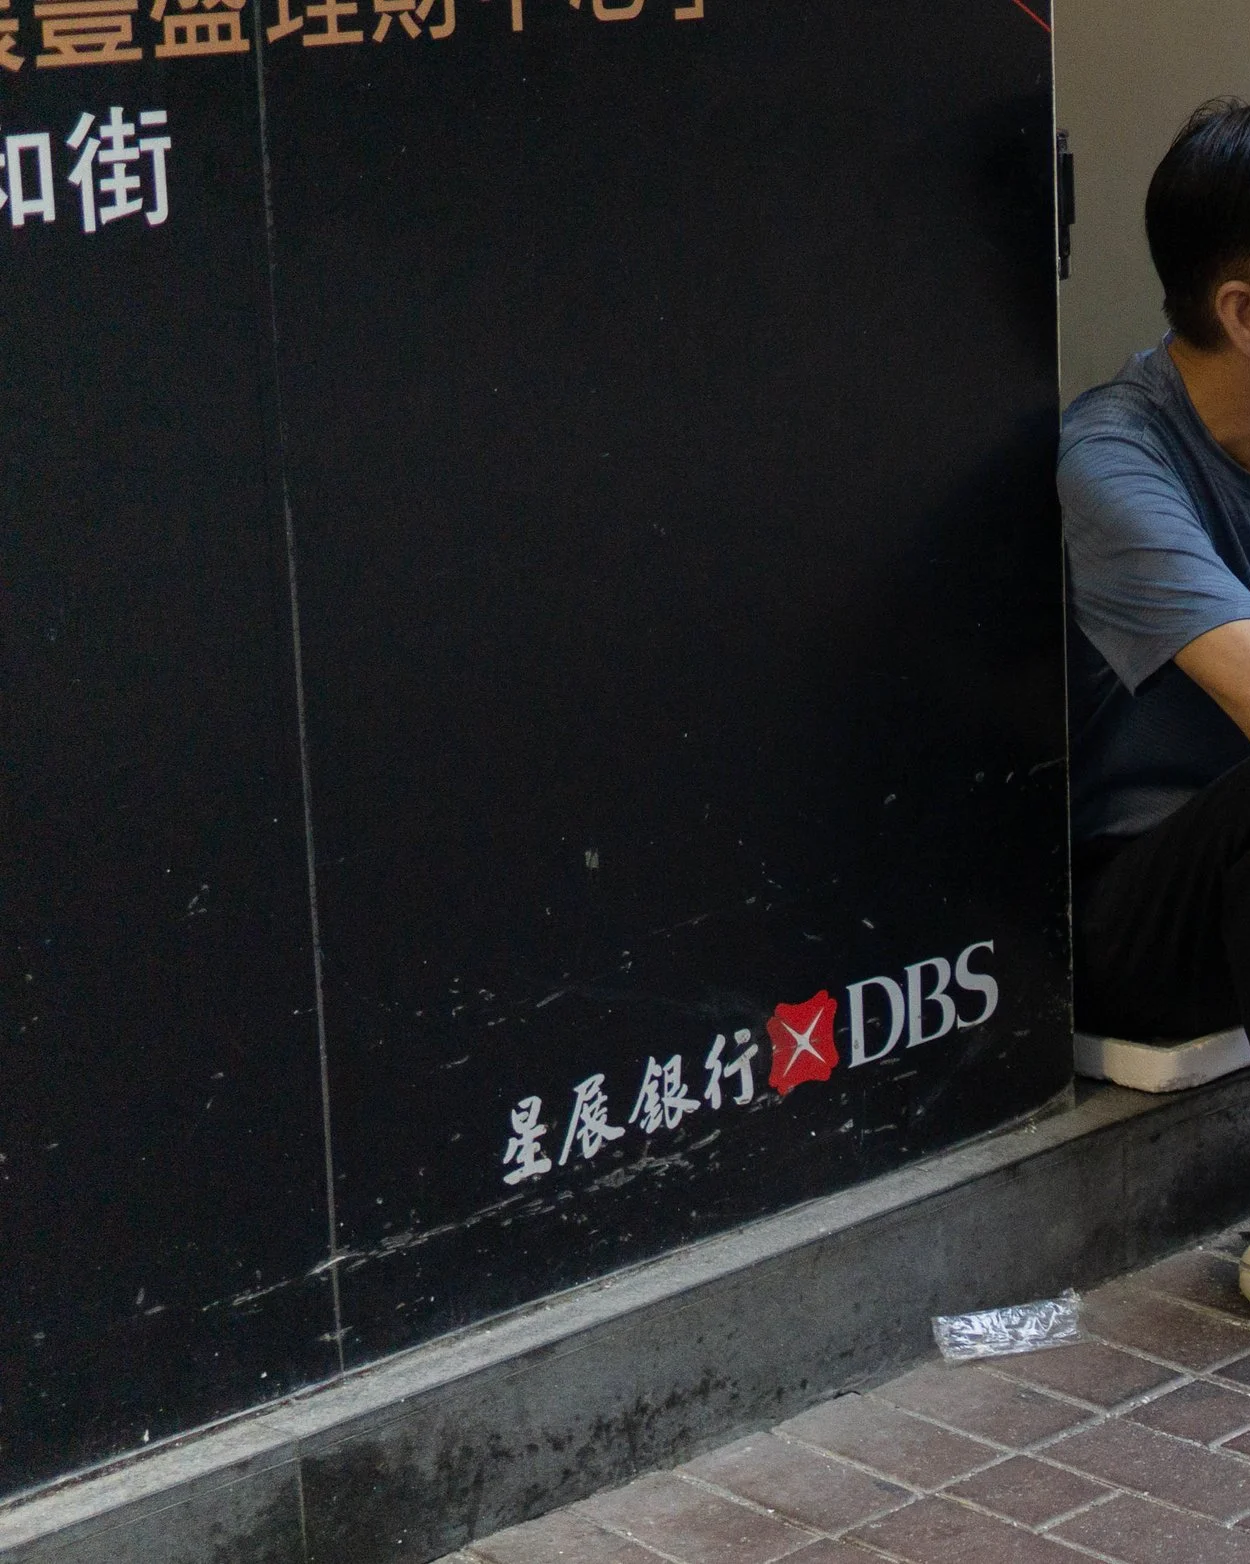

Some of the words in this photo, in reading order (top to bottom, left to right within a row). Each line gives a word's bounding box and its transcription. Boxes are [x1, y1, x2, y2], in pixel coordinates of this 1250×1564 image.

[503, 1029, 758, 1185] 星展銀行
[846, 940, 999, 1069] DBS
